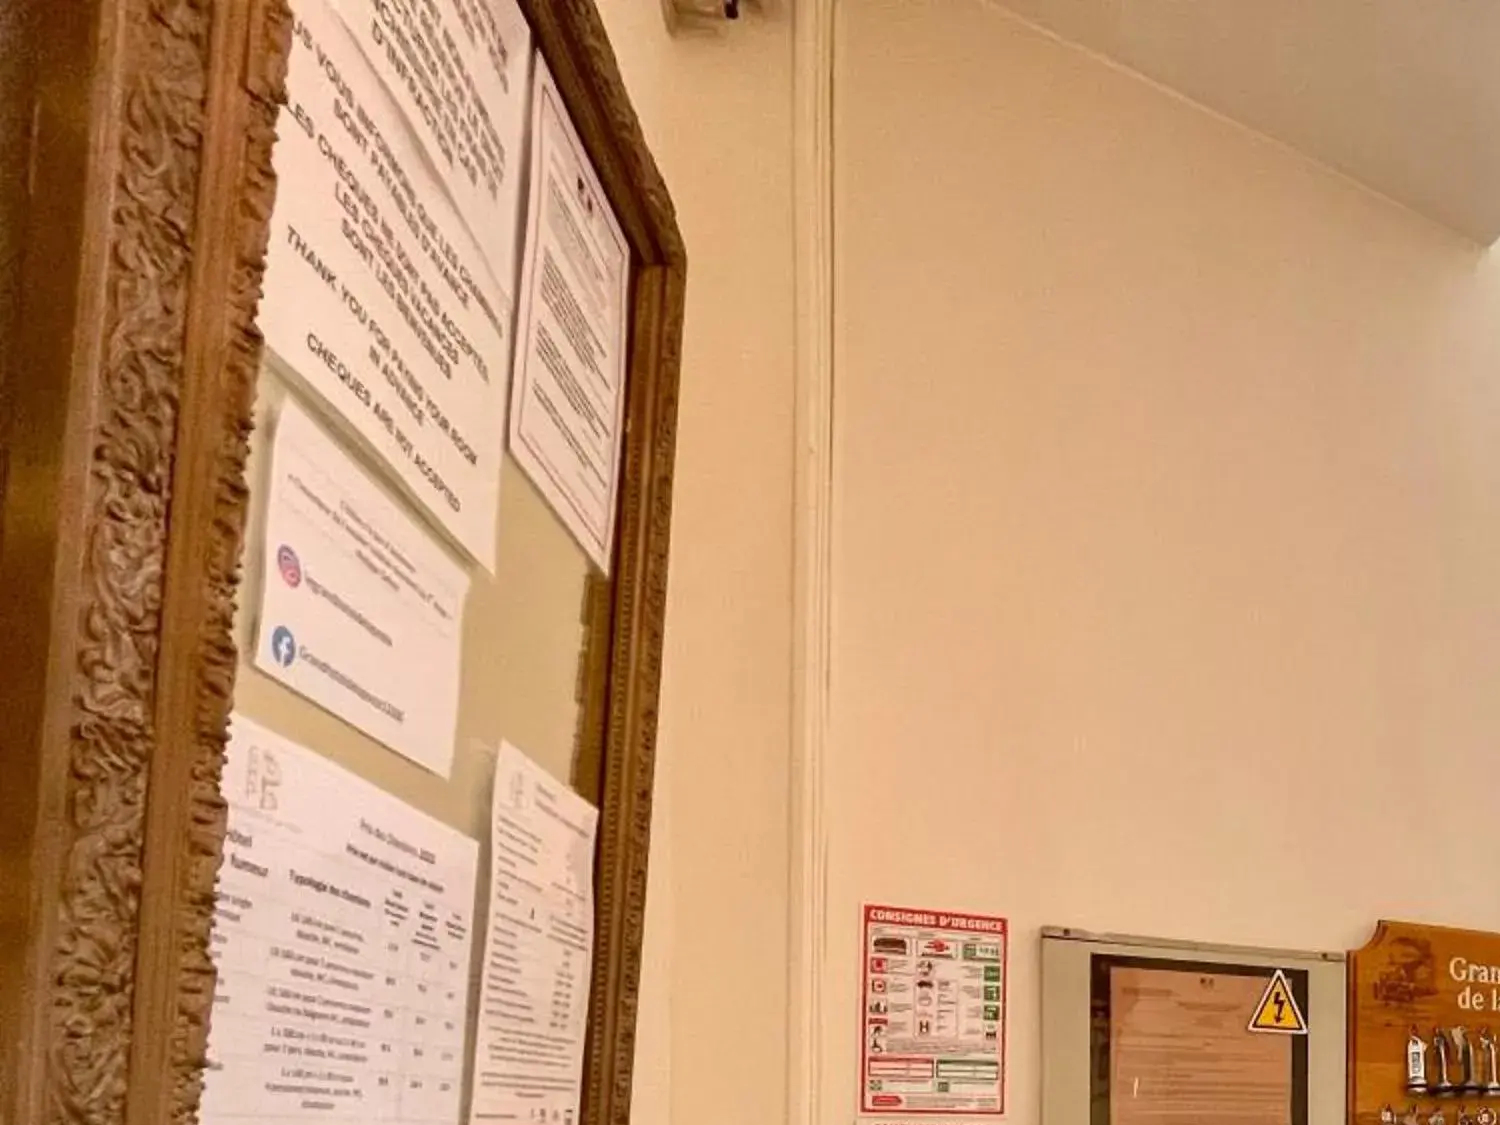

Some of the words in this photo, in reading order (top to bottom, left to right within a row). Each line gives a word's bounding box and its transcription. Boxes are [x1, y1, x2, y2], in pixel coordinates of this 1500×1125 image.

[316, 43, 354, 110] VOUS
[317, 133, 379, 225] CHEQUES
[288, 224, 337, 292] THANK
[341, 283, 368, 325] YOU
[368, 319, 391, 357] FOR
[306, 332, 372, 408] CHEQUES
[869, 909, 936, 926] CONSIGNES
[939, 915, 1003, 931] D'URGENCE
[1457, 987, 1484, 1010] de
